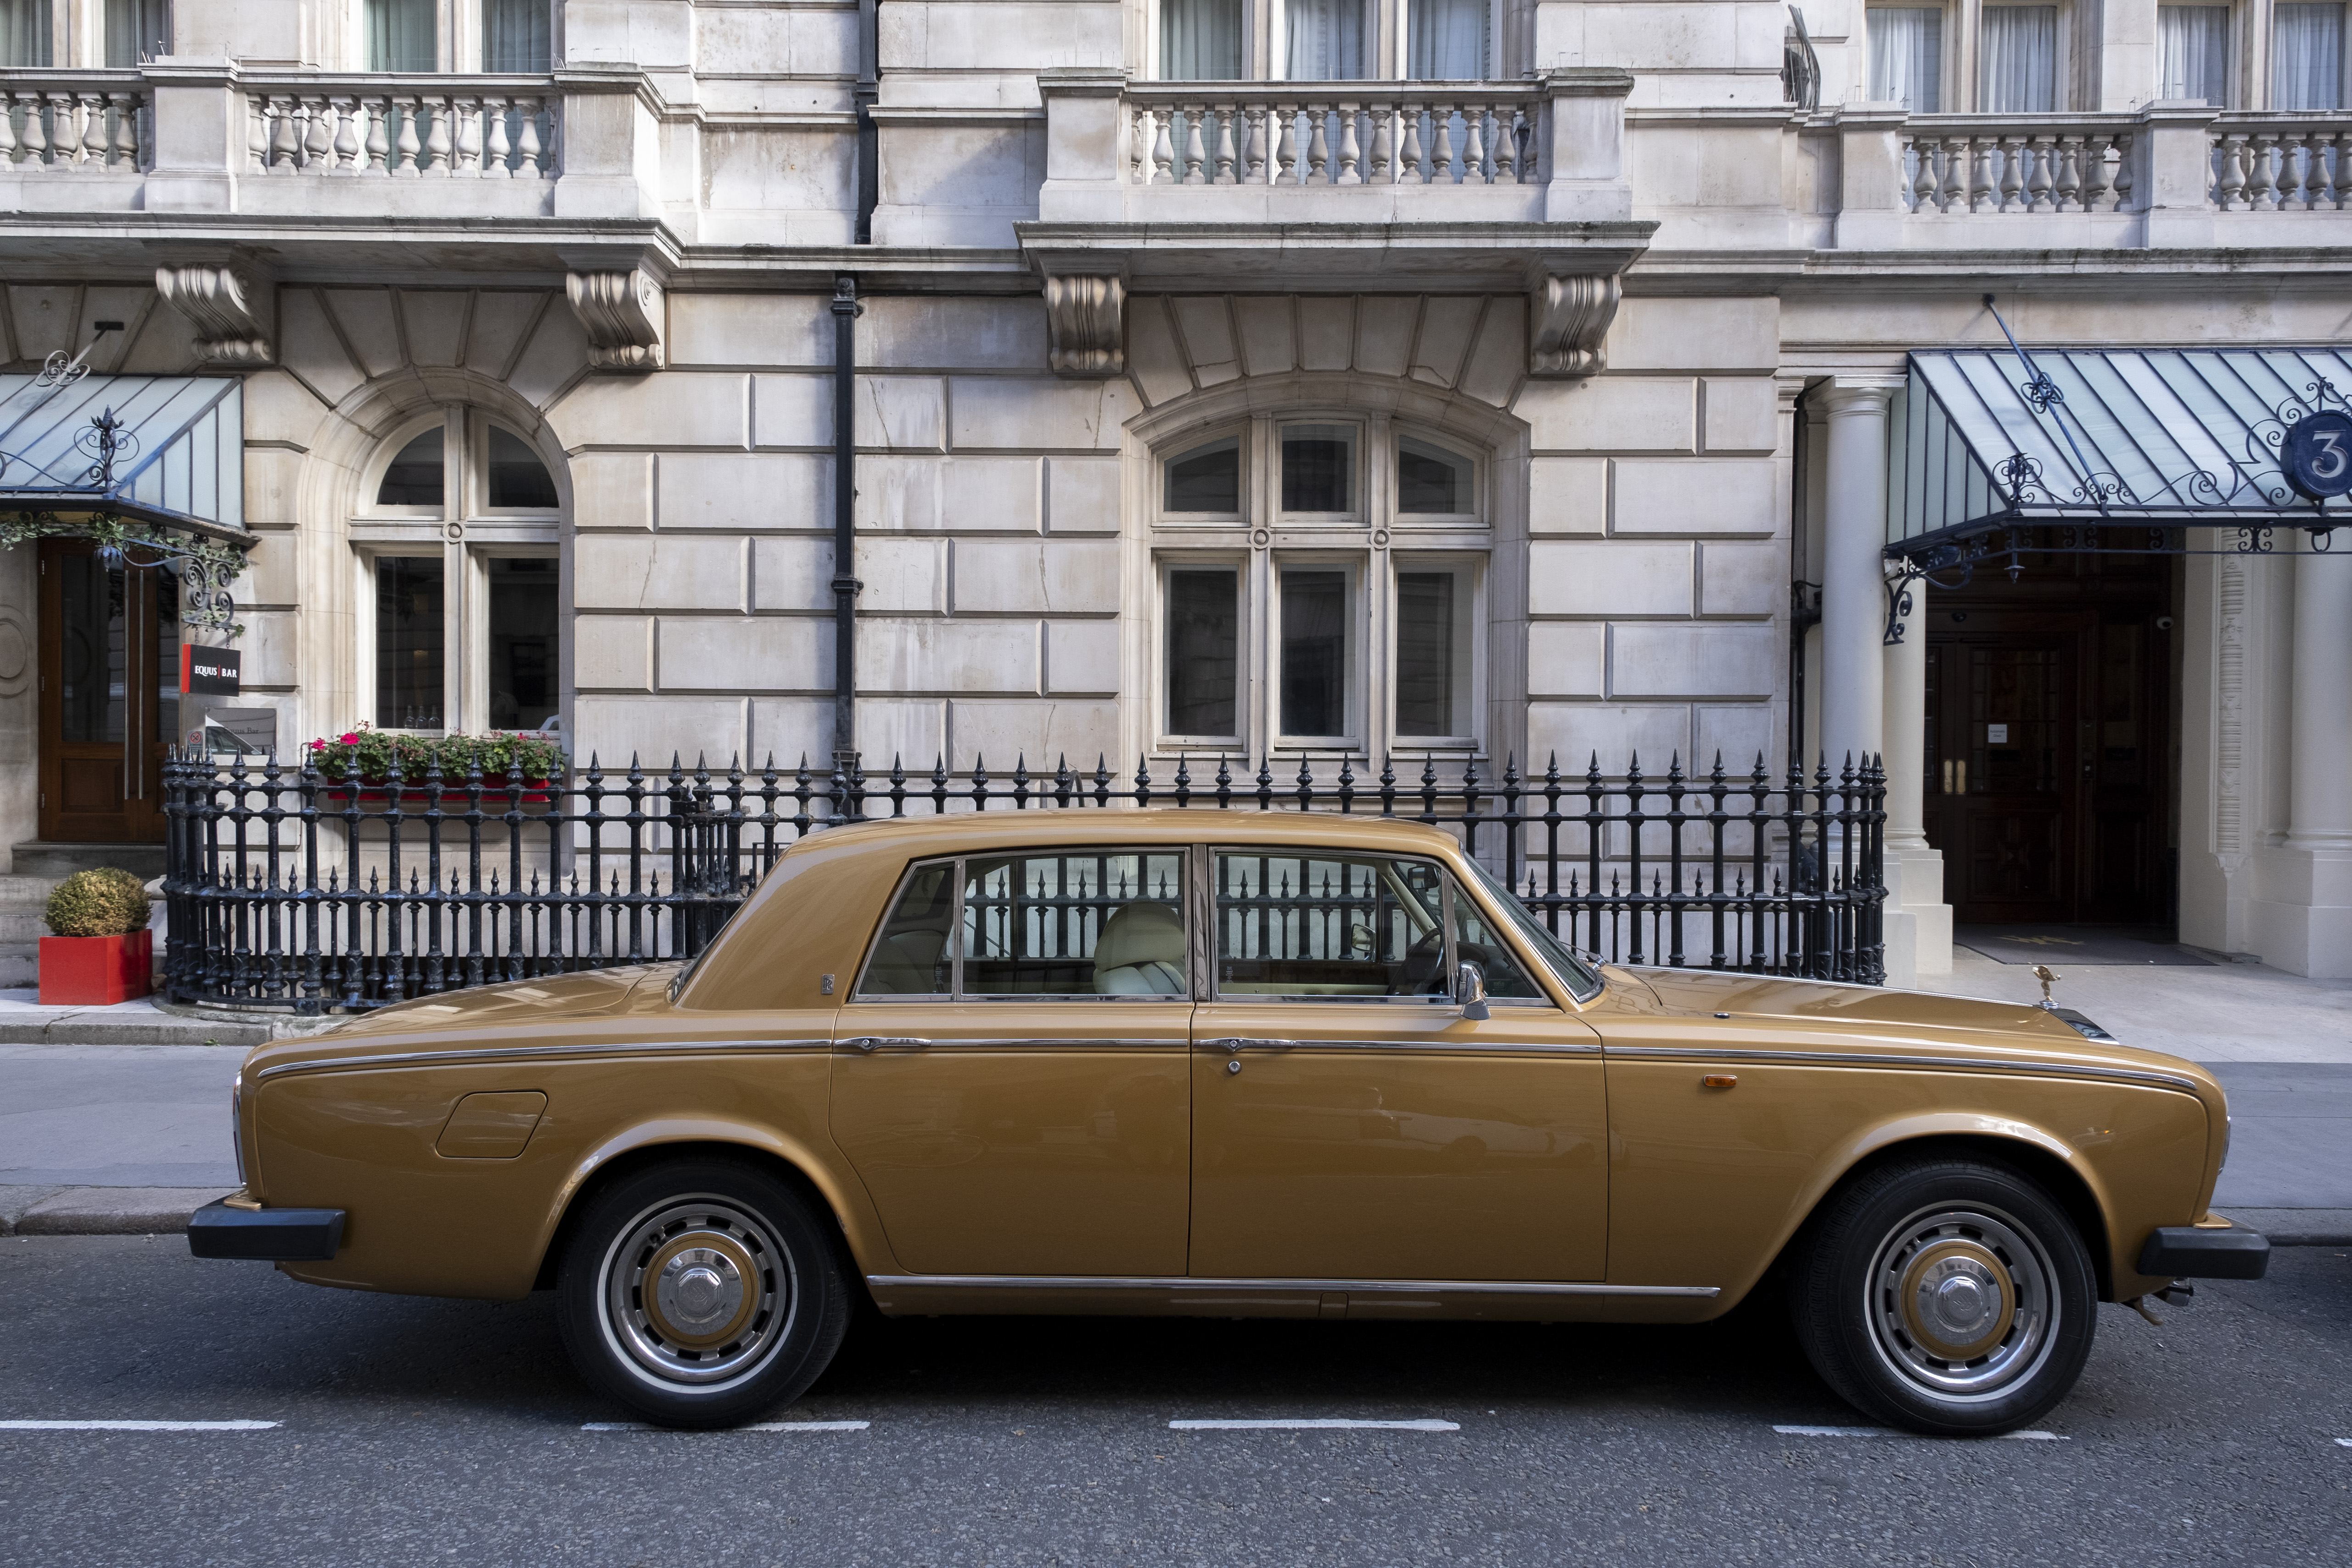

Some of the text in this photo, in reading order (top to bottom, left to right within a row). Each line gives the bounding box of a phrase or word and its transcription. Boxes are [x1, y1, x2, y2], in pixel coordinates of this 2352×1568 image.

[2312, 429, 2348, 478] 3
[195, 665, 237, 678] EQUUS BAR
